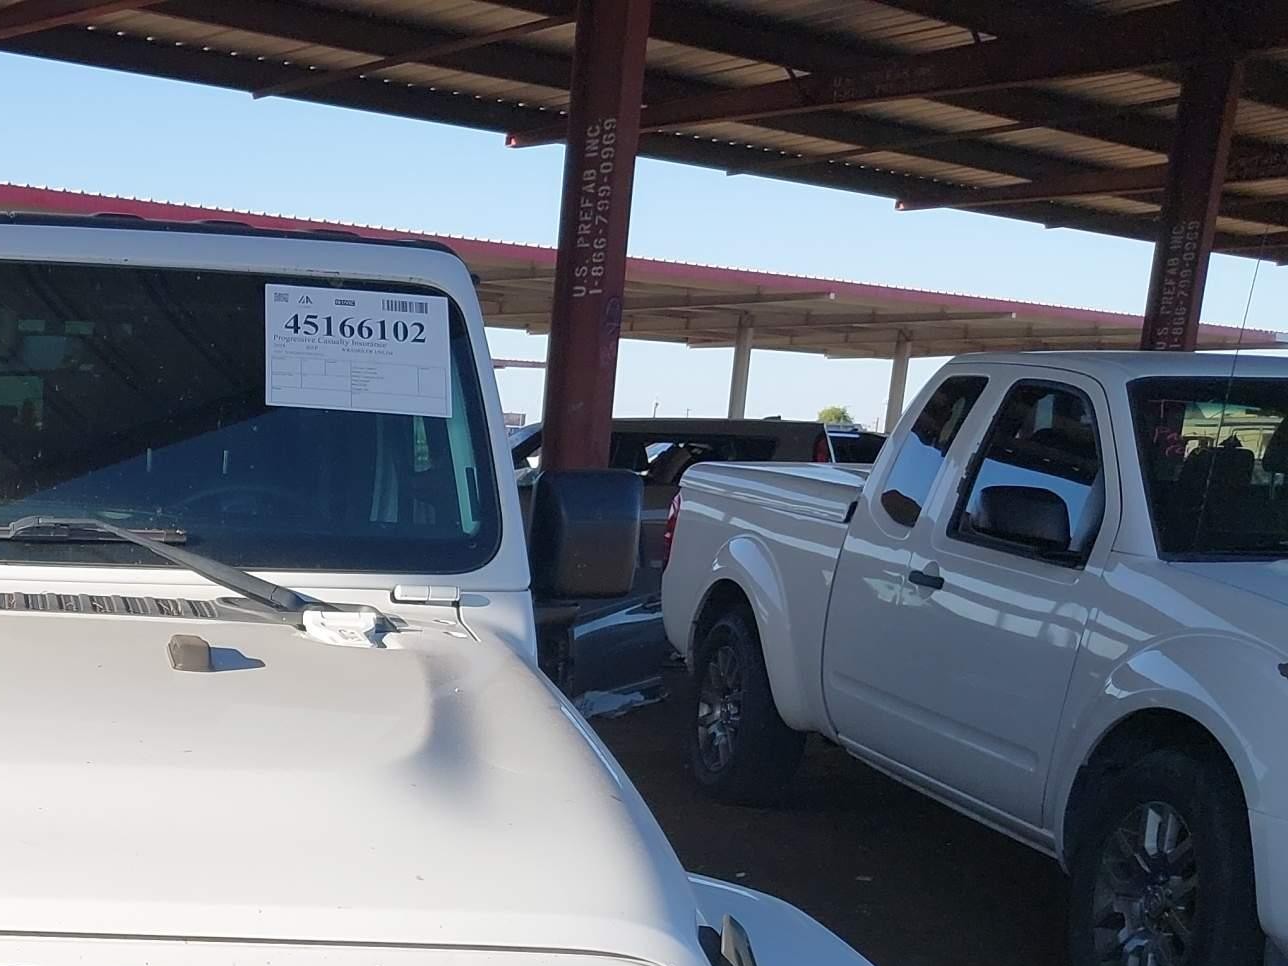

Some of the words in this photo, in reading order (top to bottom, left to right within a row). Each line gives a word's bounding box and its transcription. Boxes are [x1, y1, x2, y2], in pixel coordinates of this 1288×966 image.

[576, 168, 597, 248] PREFAB
[588, 117, 617, 295] 1-866-799-0969
[273, 334, 316, 346] Progressive
[317, 337, 350, 347] Casualty
[351, 339, 388, 349] Insurance
[284, 313, 427, 344] 45166102
